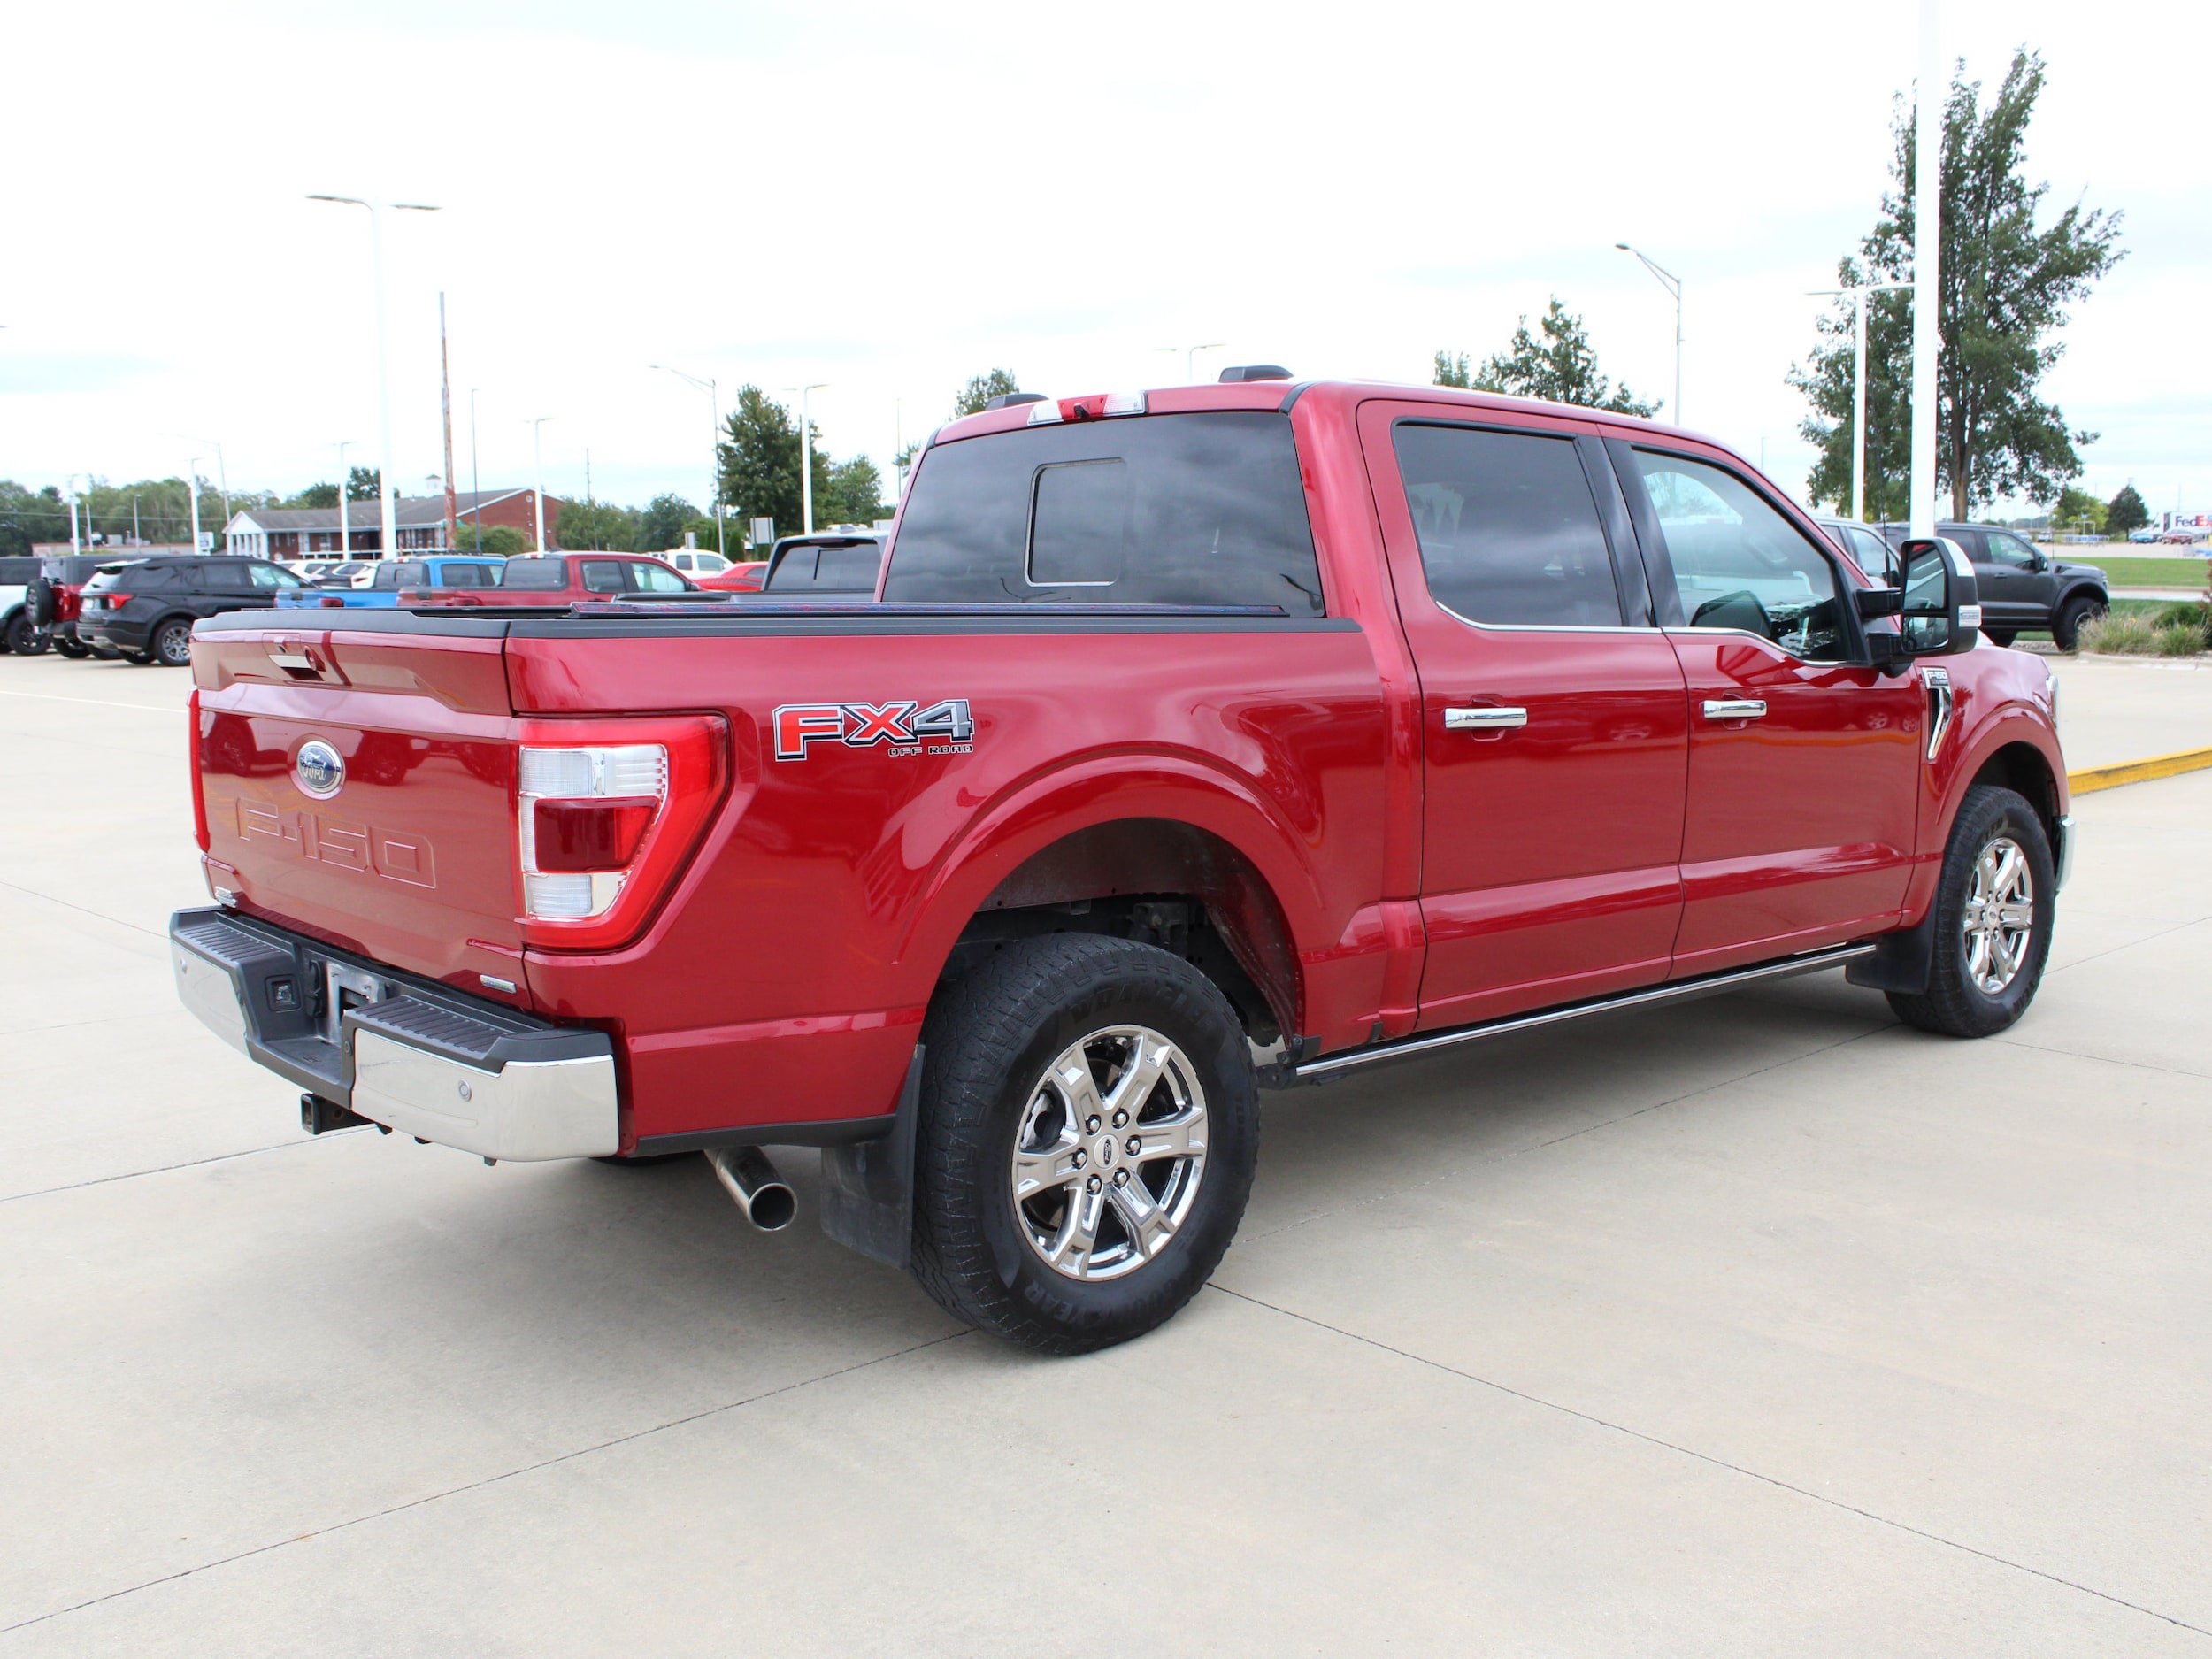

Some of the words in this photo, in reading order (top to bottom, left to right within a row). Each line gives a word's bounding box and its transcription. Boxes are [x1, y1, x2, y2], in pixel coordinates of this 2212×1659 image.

[2175, 515, 2211, 527] FedE
[772, 699, 975, 763] FX4
[887, 746, 923, 758] OFF
[927, 744, 974, 757] ROAD
[235, 797, 437, 890] F-150
